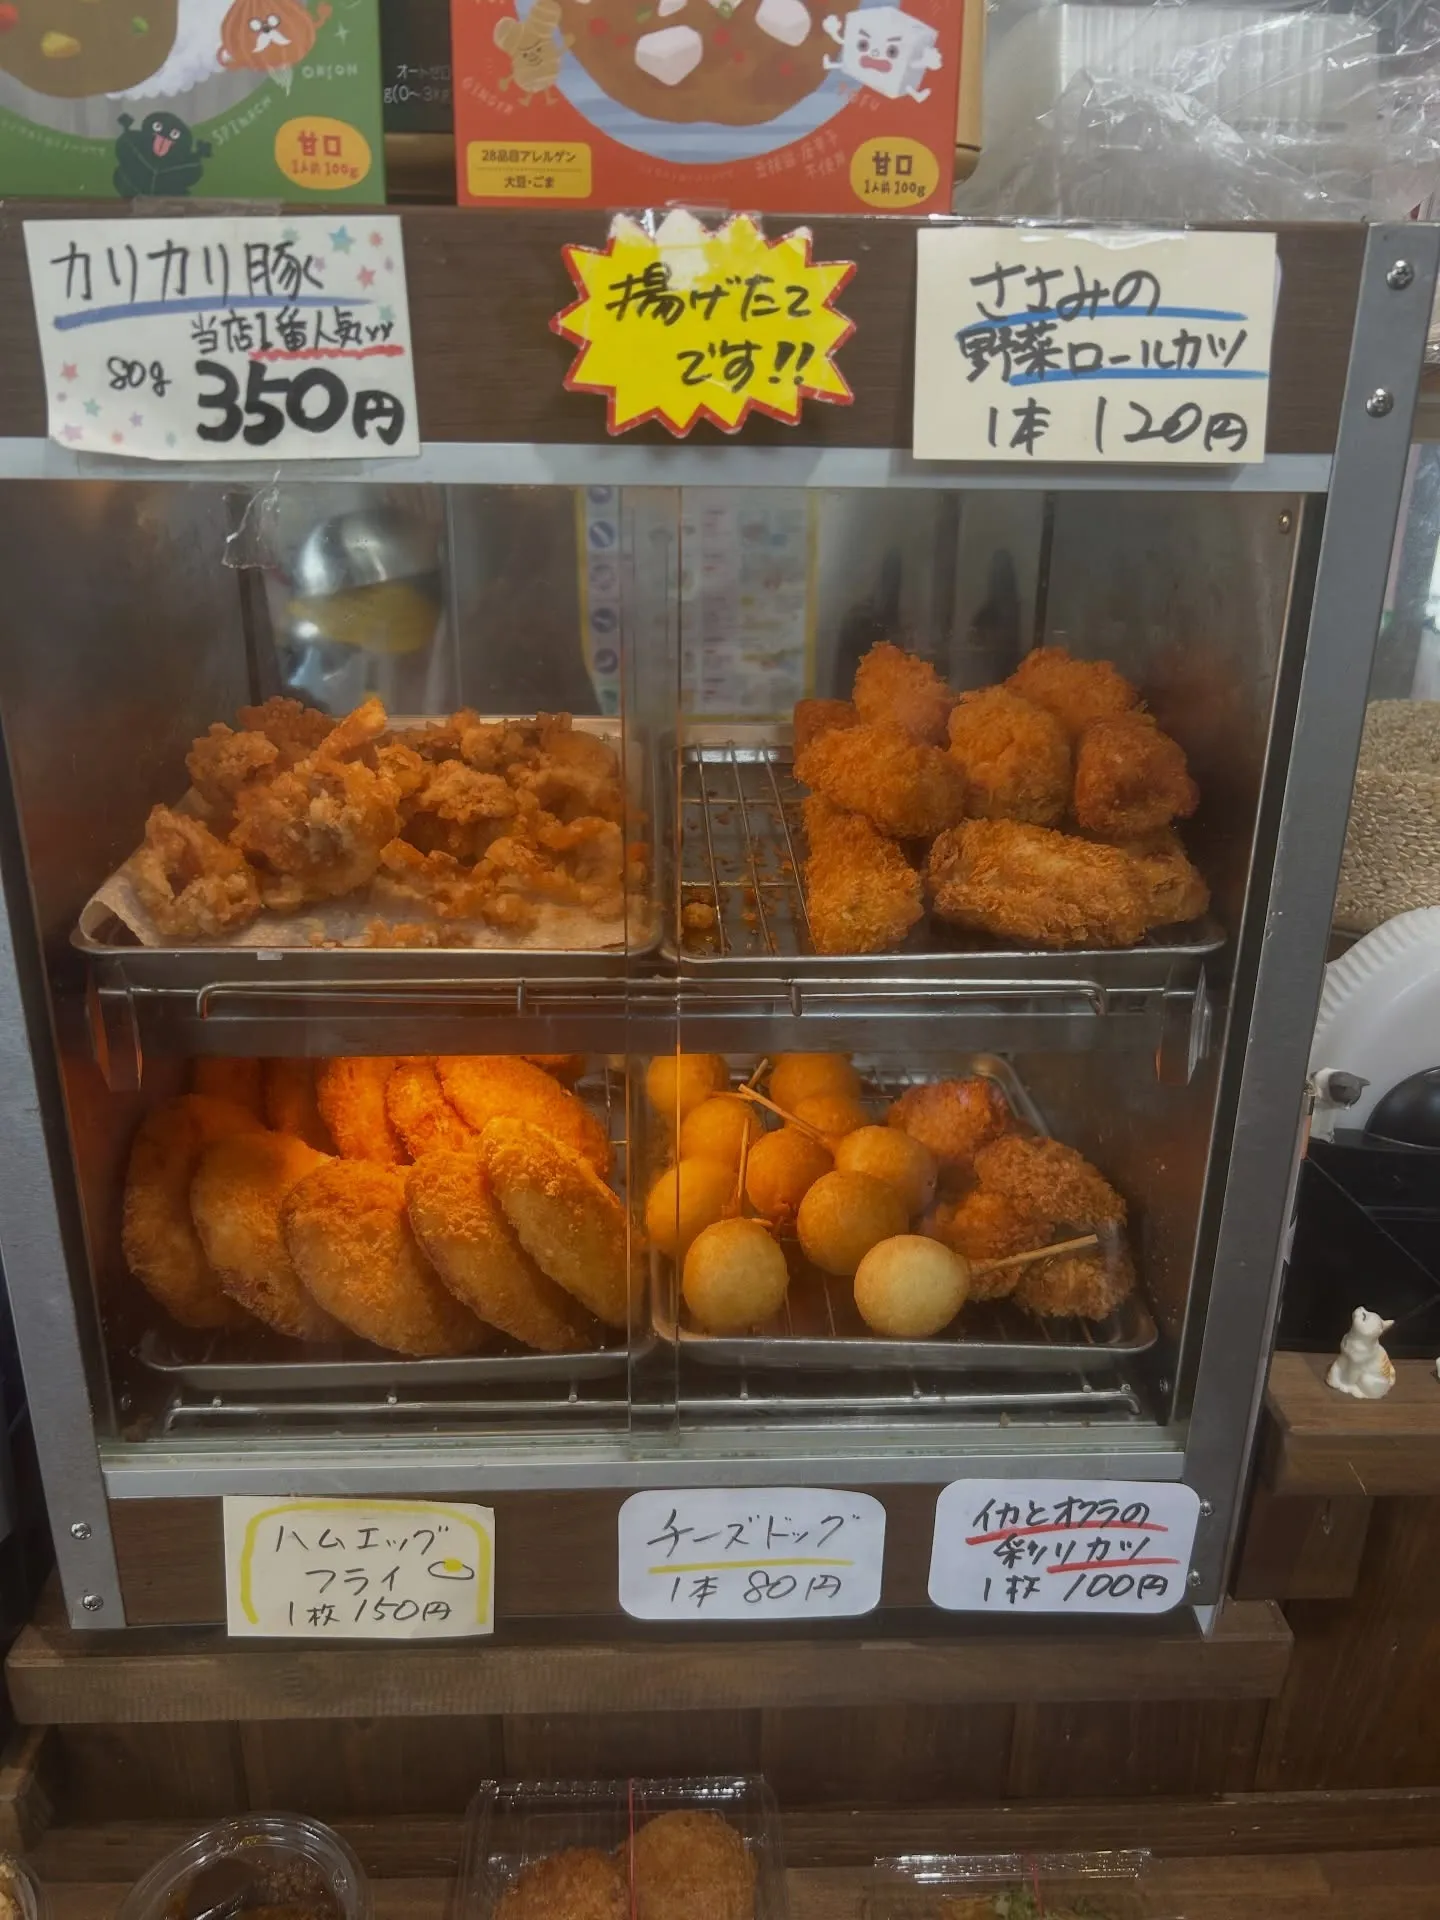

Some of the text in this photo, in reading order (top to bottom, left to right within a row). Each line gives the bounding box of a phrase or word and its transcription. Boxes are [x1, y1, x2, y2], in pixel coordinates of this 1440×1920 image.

[297, 130, 342, 157] 甘口
[871, 151, 913, 176] 甘口
[605, 262, 813, 326] 揚げたて
[969, 261, 1162, 322] ささみの
[958, 320, 1248, 383] 野菜ロールカツ
[107, 356, 405, 446] 80g 350円
[647, 1508, 861, 1558] チーズドッグ
[972, 1495, 1150, 1532] イカとオクラの
[275, 1525, 449, 1556] ハムエッグ
[305, 1566, 400, 1596] フライ
